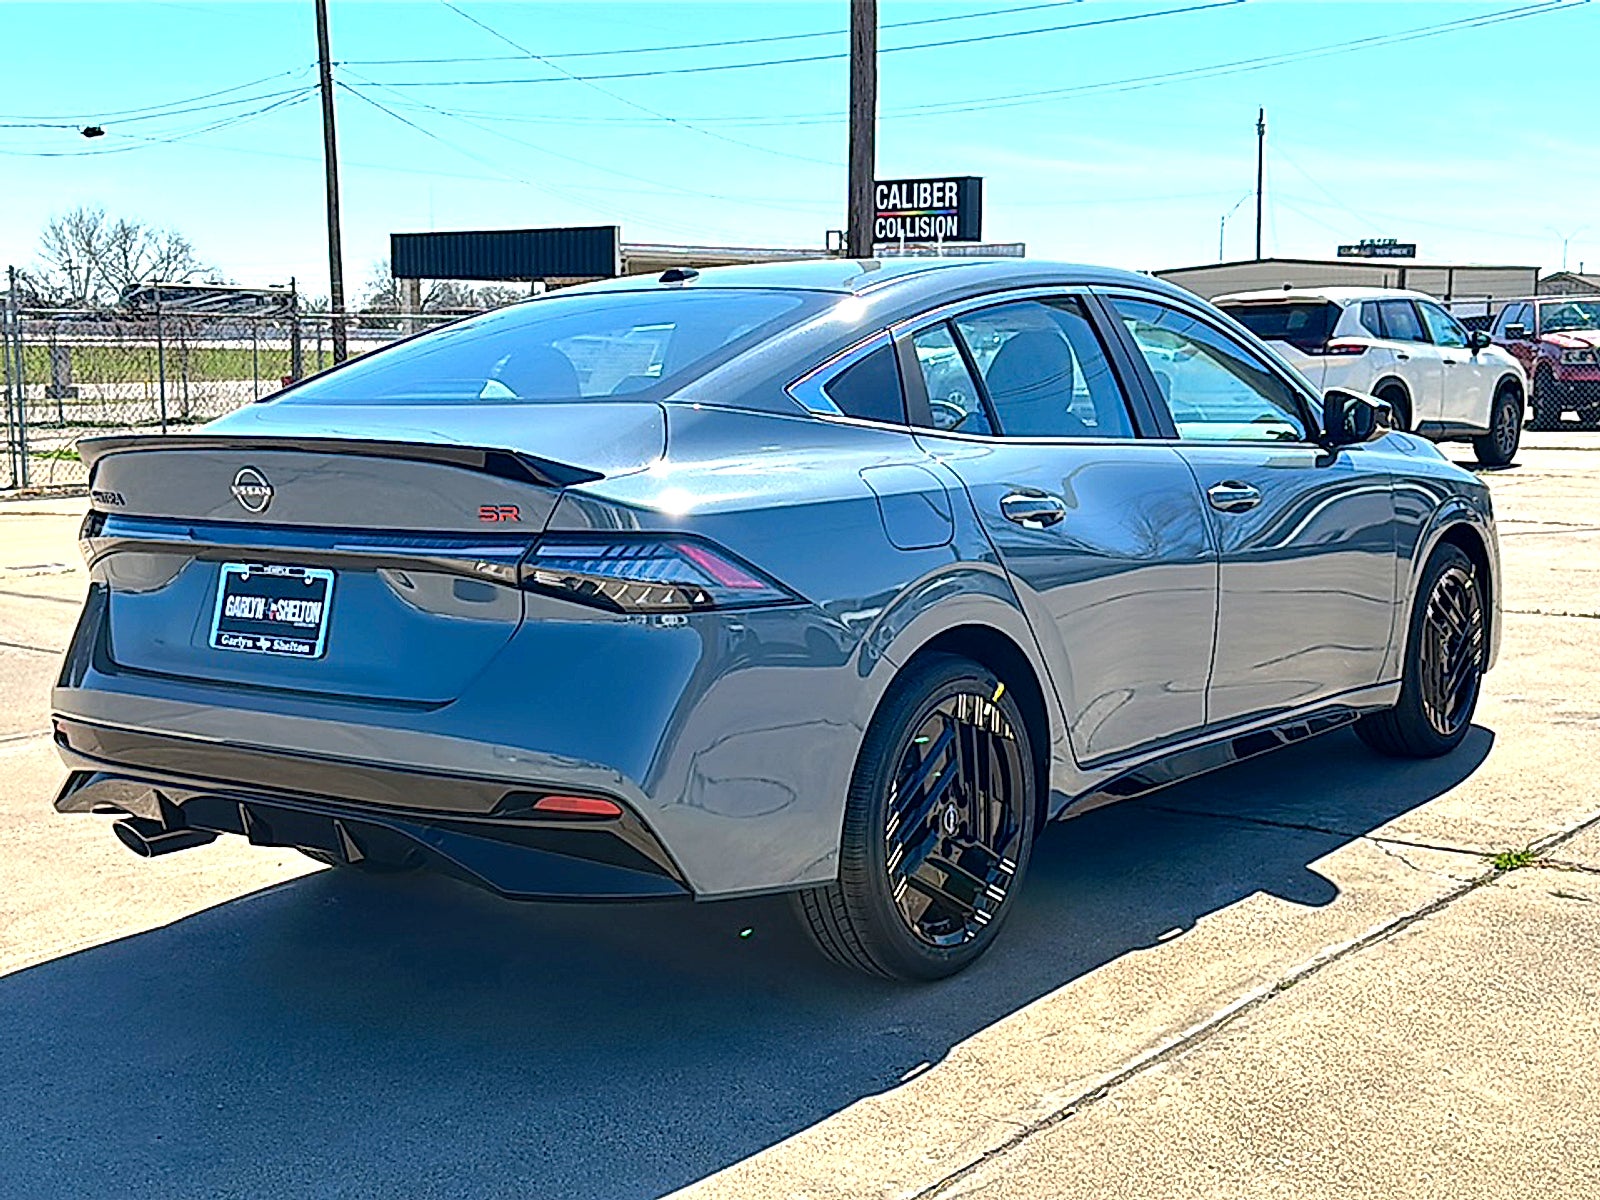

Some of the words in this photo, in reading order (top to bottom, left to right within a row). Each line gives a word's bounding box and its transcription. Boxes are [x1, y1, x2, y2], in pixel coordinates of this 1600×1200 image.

[875, 181, 958, 210] CALIBER
[875, 216, 958, 238] COLLISION
[478, 504, 522, 522] SR
